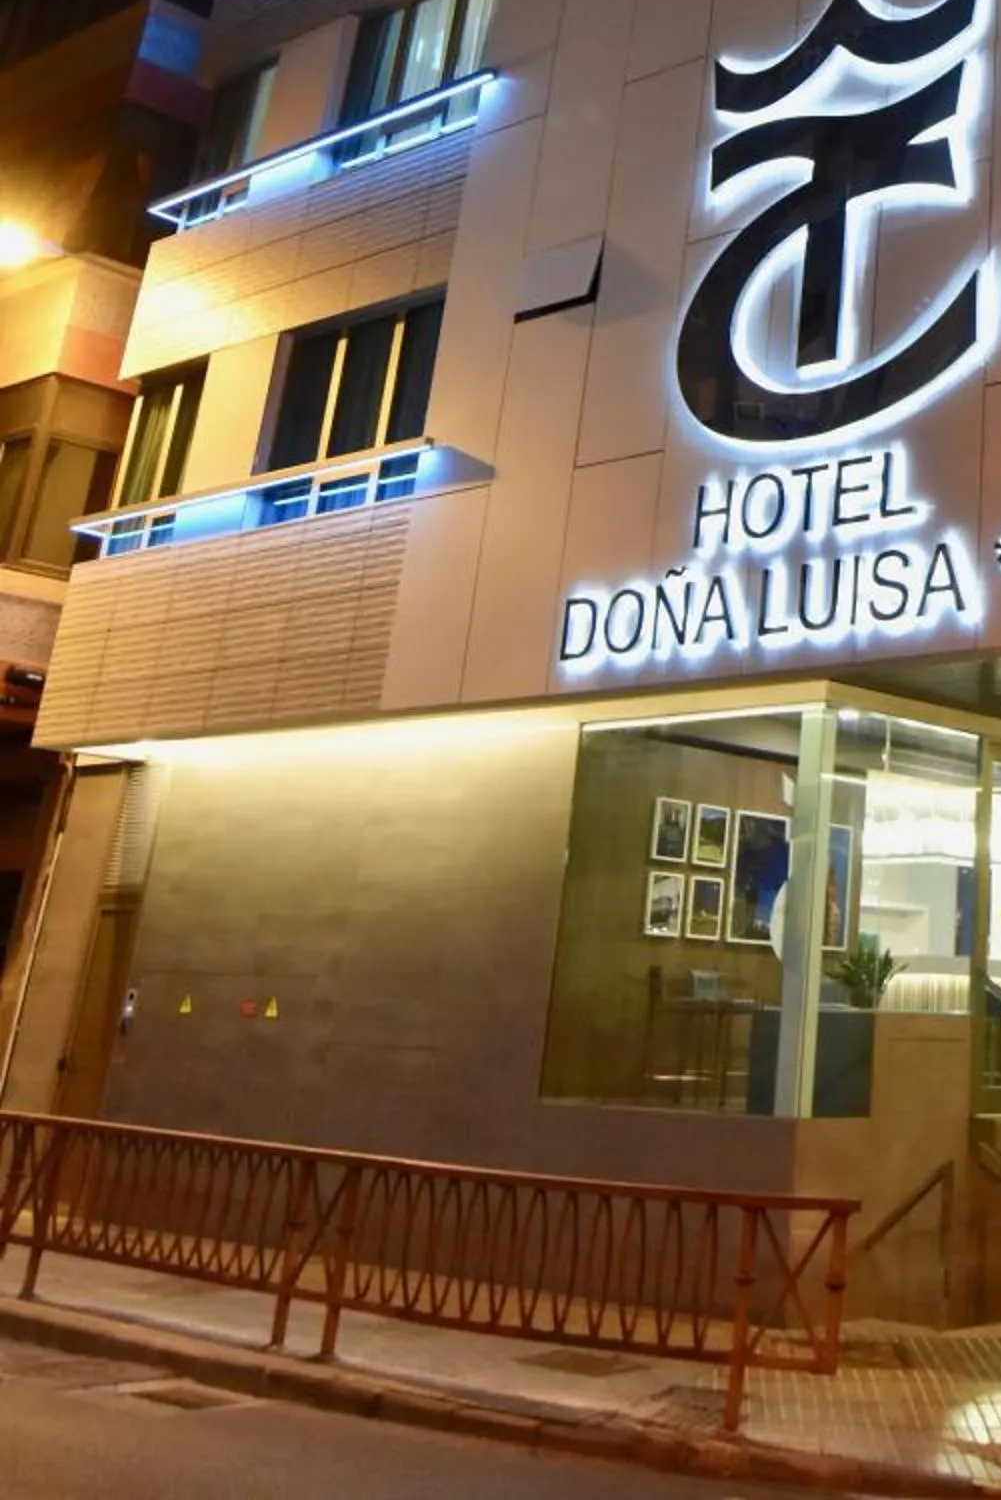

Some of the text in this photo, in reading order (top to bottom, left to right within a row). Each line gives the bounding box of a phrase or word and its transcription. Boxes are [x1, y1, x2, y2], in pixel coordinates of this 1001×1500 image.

[693, 451, 917, 548] HOTEL
[560, 542, 966, 660] DOÑA LUISA
